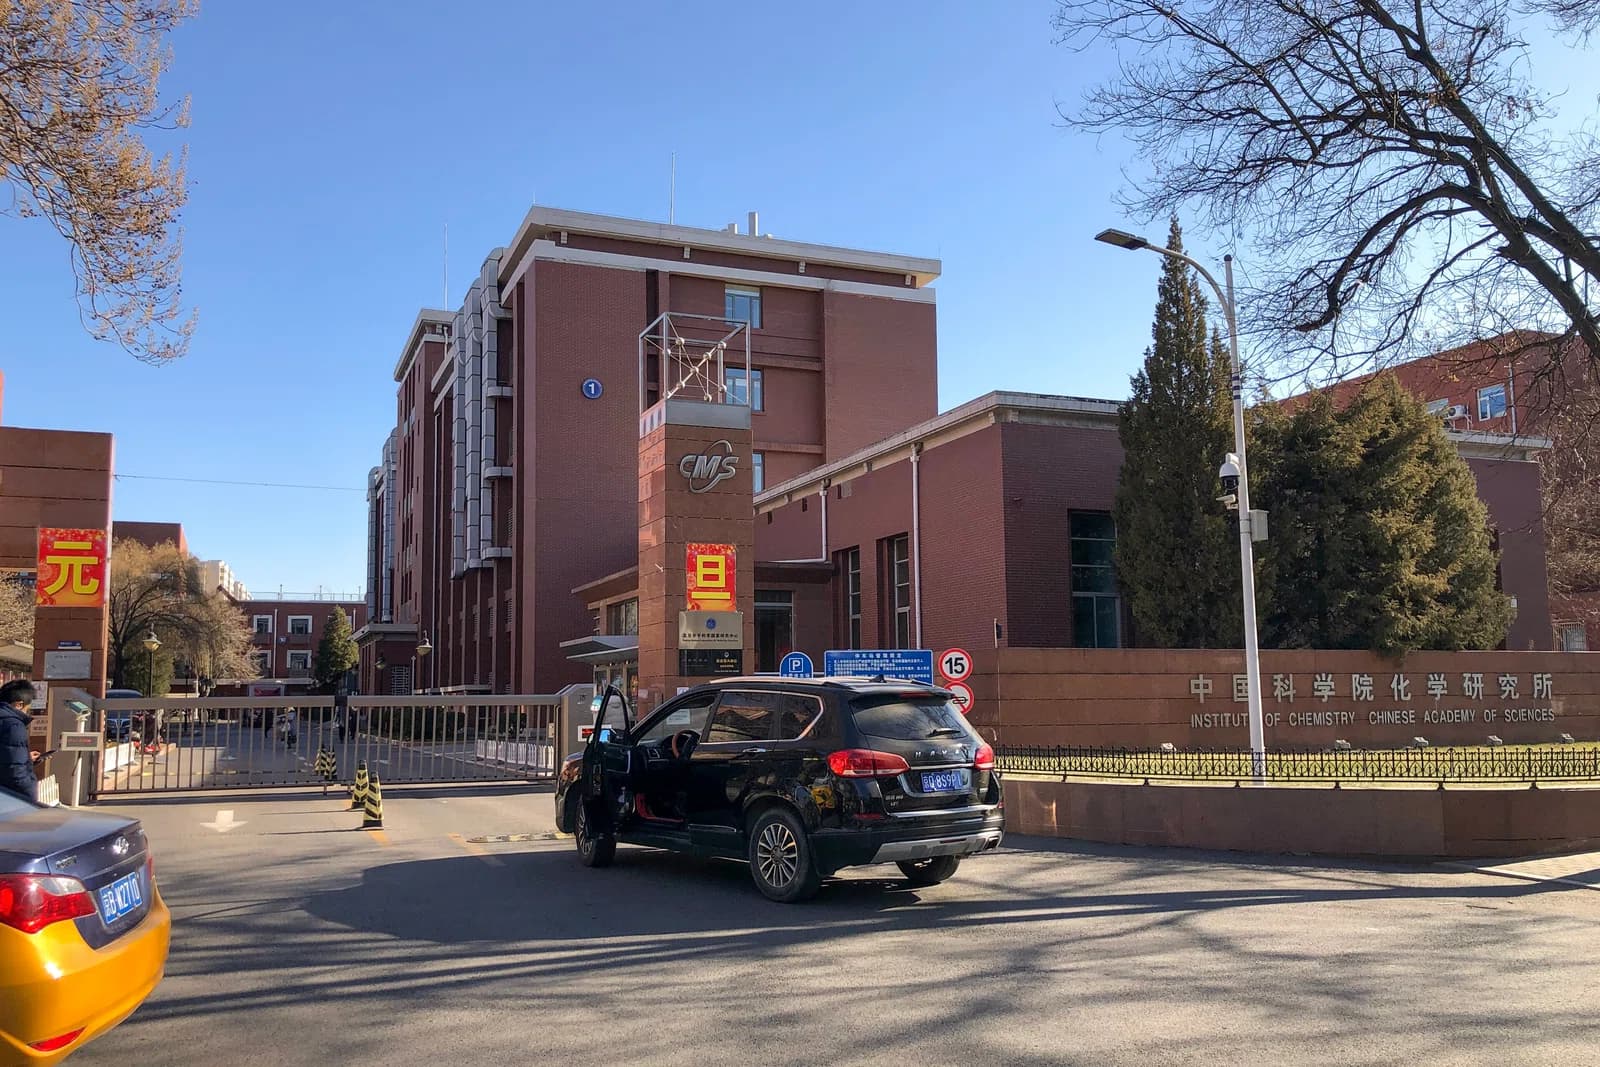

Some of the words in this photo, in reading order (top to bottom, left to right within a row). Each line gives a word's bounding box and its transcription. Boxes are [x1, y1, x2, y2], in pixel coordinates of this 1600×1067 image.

[588, 383, 595, 395] 1
[679, 451, 740, 483] CMS
[44, 541, 100, 596] 元
[690, 554, 732, 601] 旦
[792, 659, 801, 671] P
[945, 656, 966, 675] 15
[1190, 673, 1553, 703] 中国科学院化学研究所
[1191, 713, 1249, 728] INSTITUT
[1264, 712, 1281, 727] OF
[1288, 711, 1355, 727] CHEMISTRY
[1368, 709, 1416, 725] CHINESE
[1423, 709, 1476, 724] ACADEMY
[1483, 708, 1497, 723] OF
[1504, 707, 1555, 723] SCIENCES
